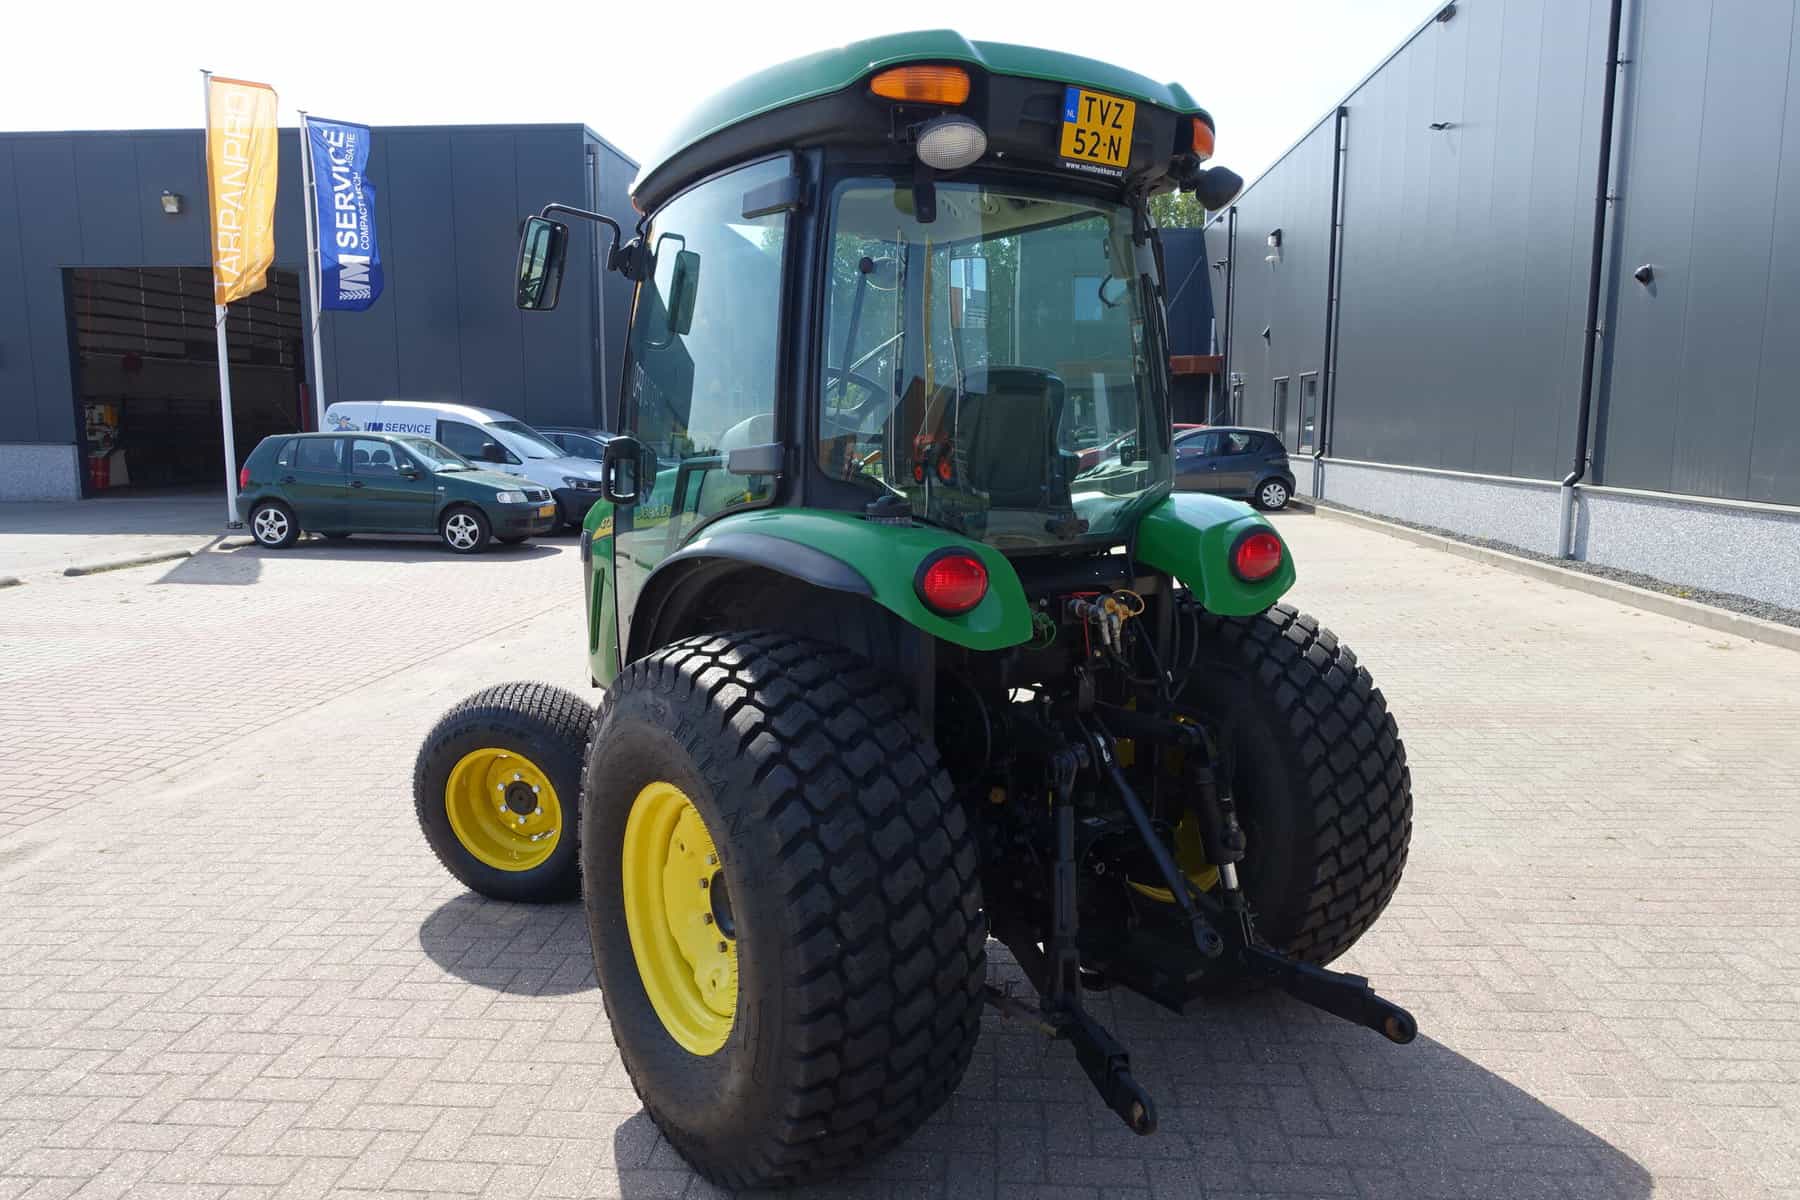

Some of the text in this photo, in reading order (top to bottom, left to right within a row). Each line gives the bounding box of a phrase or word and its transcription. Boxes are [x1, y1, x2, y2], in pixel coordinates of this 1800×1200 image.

[1066, 108, 1076, 118] NL
[1085, 96, 1124, 129] TVZ
[322, 129, 358, 248] SERVICE
[358, 201, 370, 250] COMPACT
[384, 422, 431, 434] SERVICE
